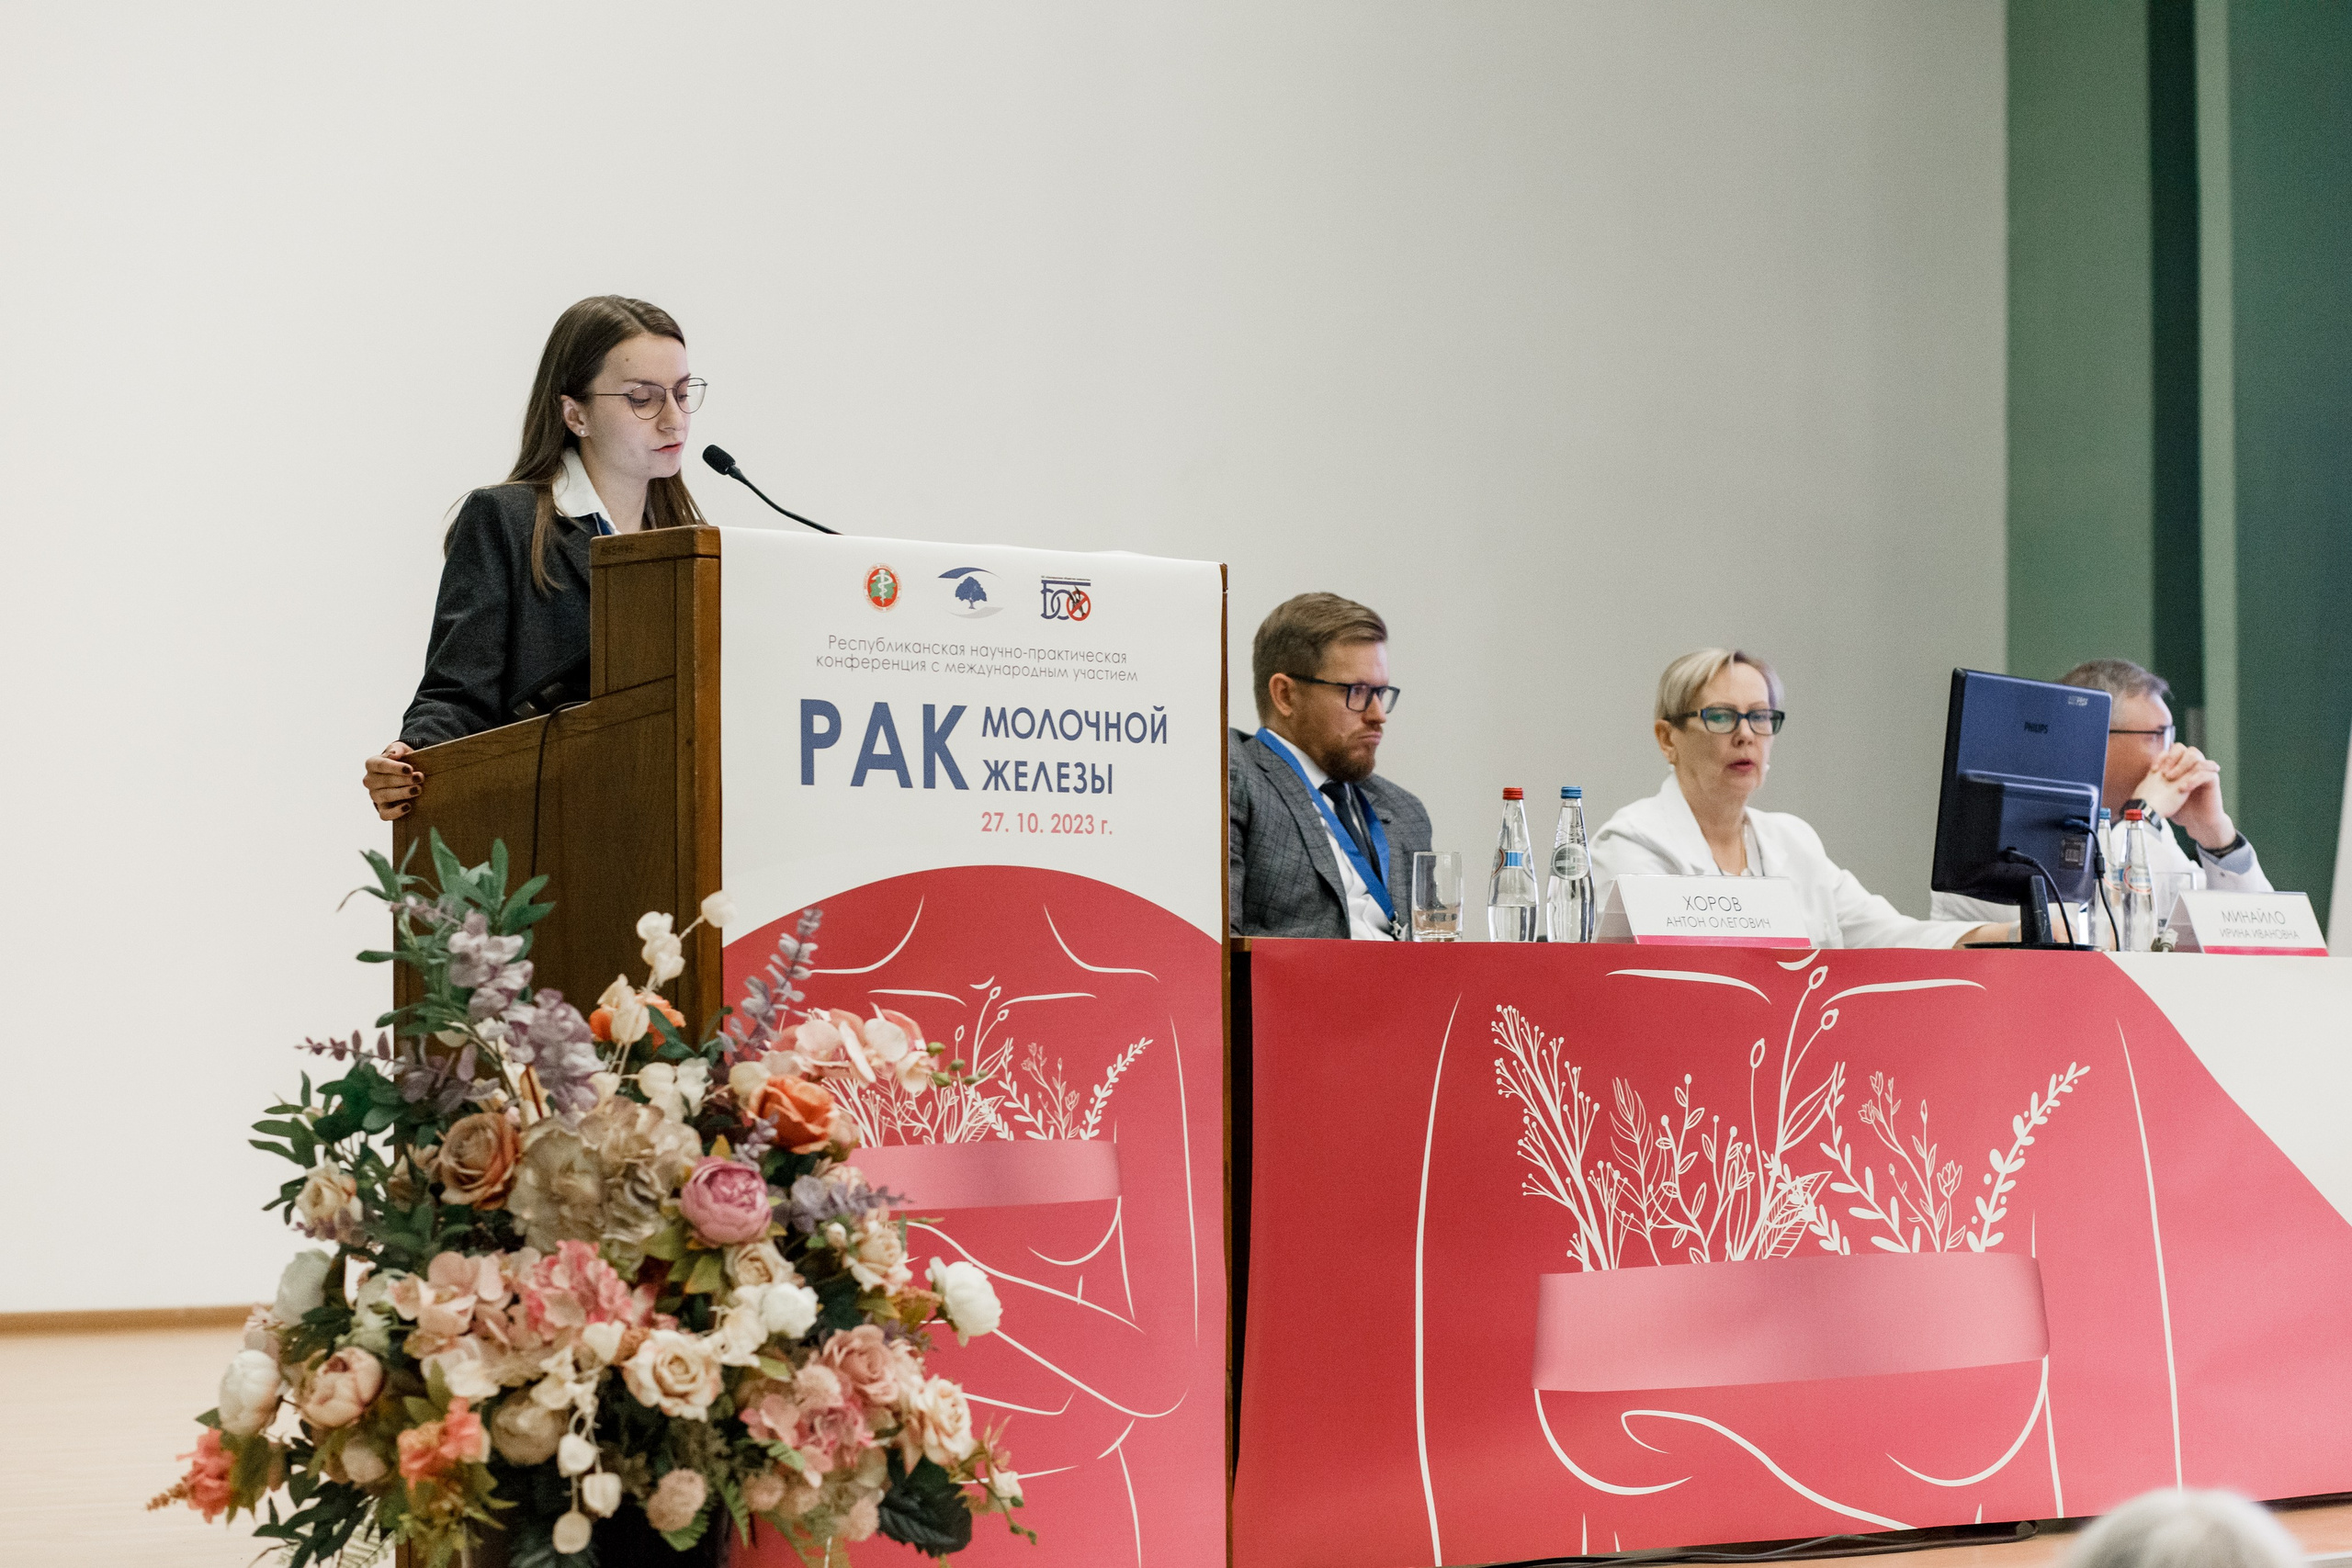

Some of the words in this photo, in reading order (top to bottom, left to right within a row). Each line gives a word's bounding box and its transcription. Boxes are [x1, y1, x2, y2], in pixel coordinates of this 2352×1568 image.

[828, 634, 966, 656] Республиканская
[970, 645, 1127, 664] научно-практическая
[816, 653, 927, 672] конференция
[931, 660, 940, 672] с
[944, 661, 1069, 678] международным
[1072, 667, 1138, 682] участием
[981, 705, 1168, 744] МОЛОЧНОЙ
[799, 698, 969, 791] РАК
[981, 759, 1113, 795] ЖЕЛЕЗЫ
[981, 811, 1009, 832] 27.
[1017, 812, 1044, 833] 10.
[1050, 813, 1094, 835] 2023
[1101, 819, 1113, 835] г.
[1682, 896, 1742, 912] ХОРОВ
[2221, 908, 2286, 925] МИНАЙЛО
[1667, 916, 1707, 928] АНТОН
[1709, 917, 1771, 929] ОЛЕГОВИЧ
[2220, 928, 2250, 938] ИРИНА
[2251, 929, 2301, 940] ИВАНОВНА
